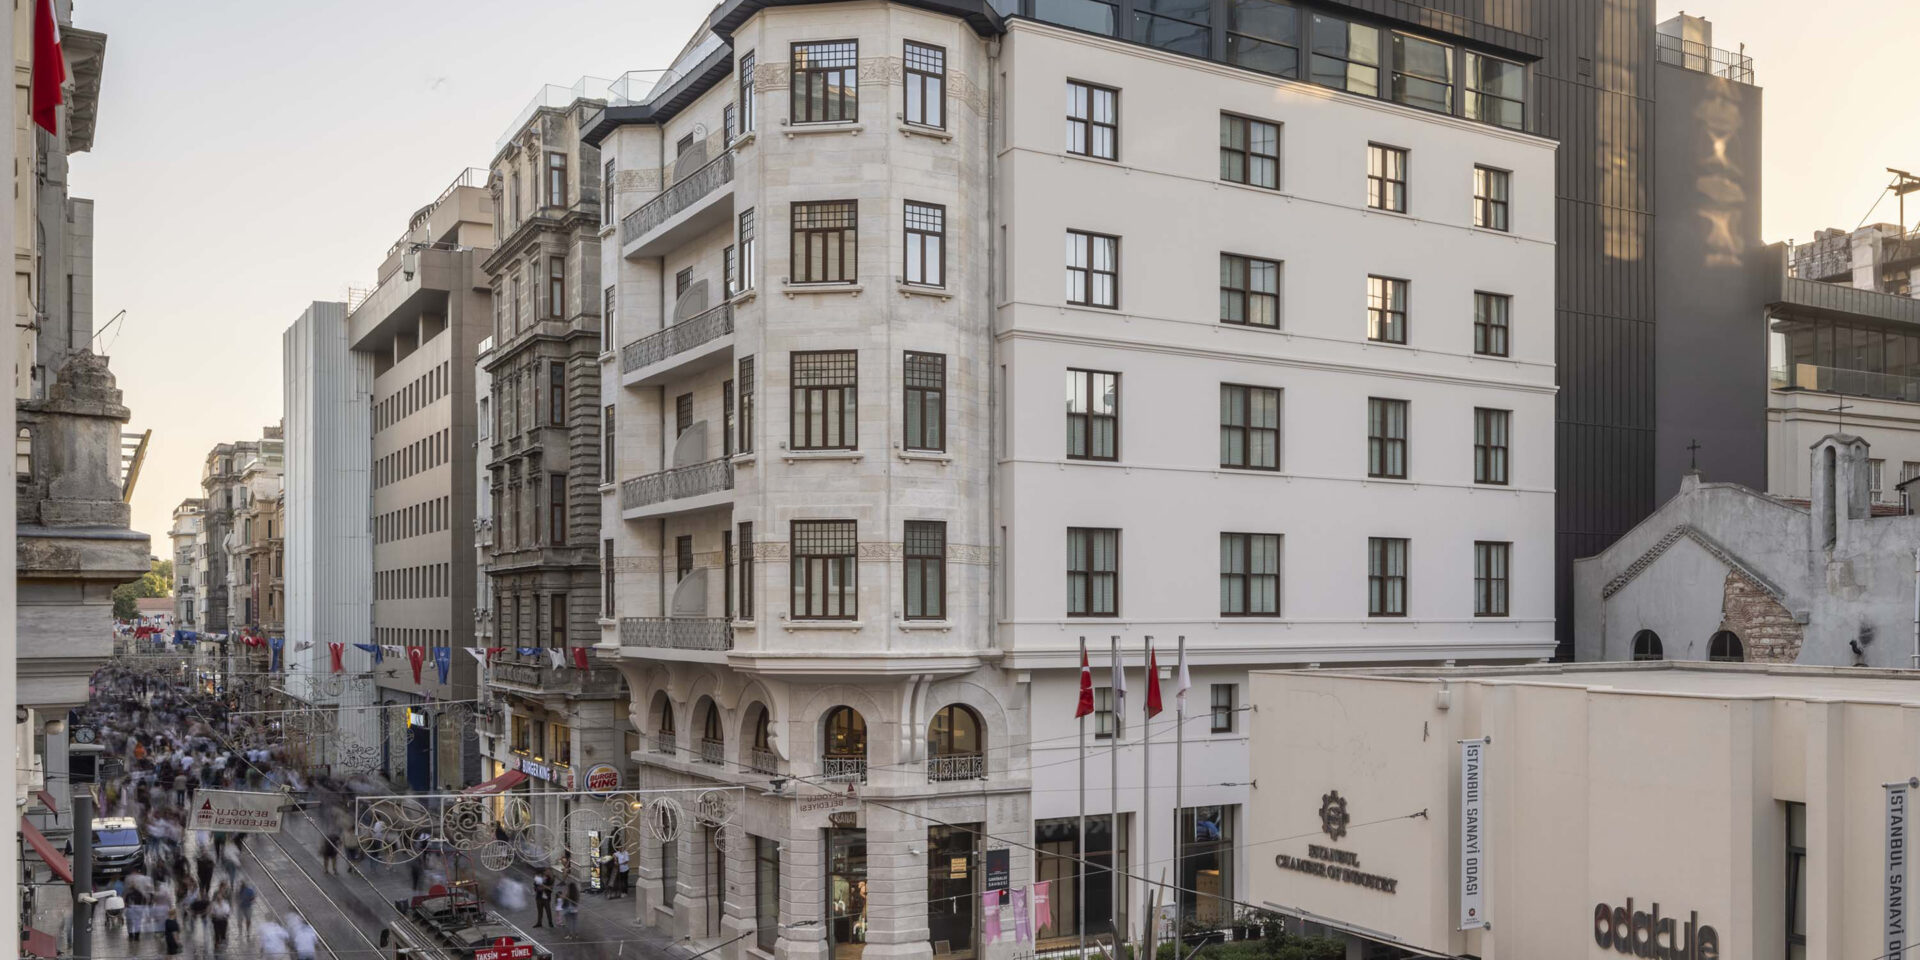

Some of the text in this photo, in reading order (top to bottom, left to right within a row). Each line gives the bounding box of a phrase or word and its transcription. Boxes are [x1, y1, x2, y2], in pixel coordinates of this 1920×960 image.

[589, 779, 618, 789] KING
[590, 772, 618, 781] BURGER
[1466, 745, 1480, 896] İSTANBUL SANAYİ ODASI
[1890, 789, 1906, 871] İSTANBUL
[1275, 854, 1398, 894] CHAMBER OF INDUSTRY
[1594, 897, 1720, 960] odakule
[1889, 874, 1904, 936] SANAYİ
[476, 951, 498, 960] TAKSİM
[511, 948, 530, 957] TÜNEL
